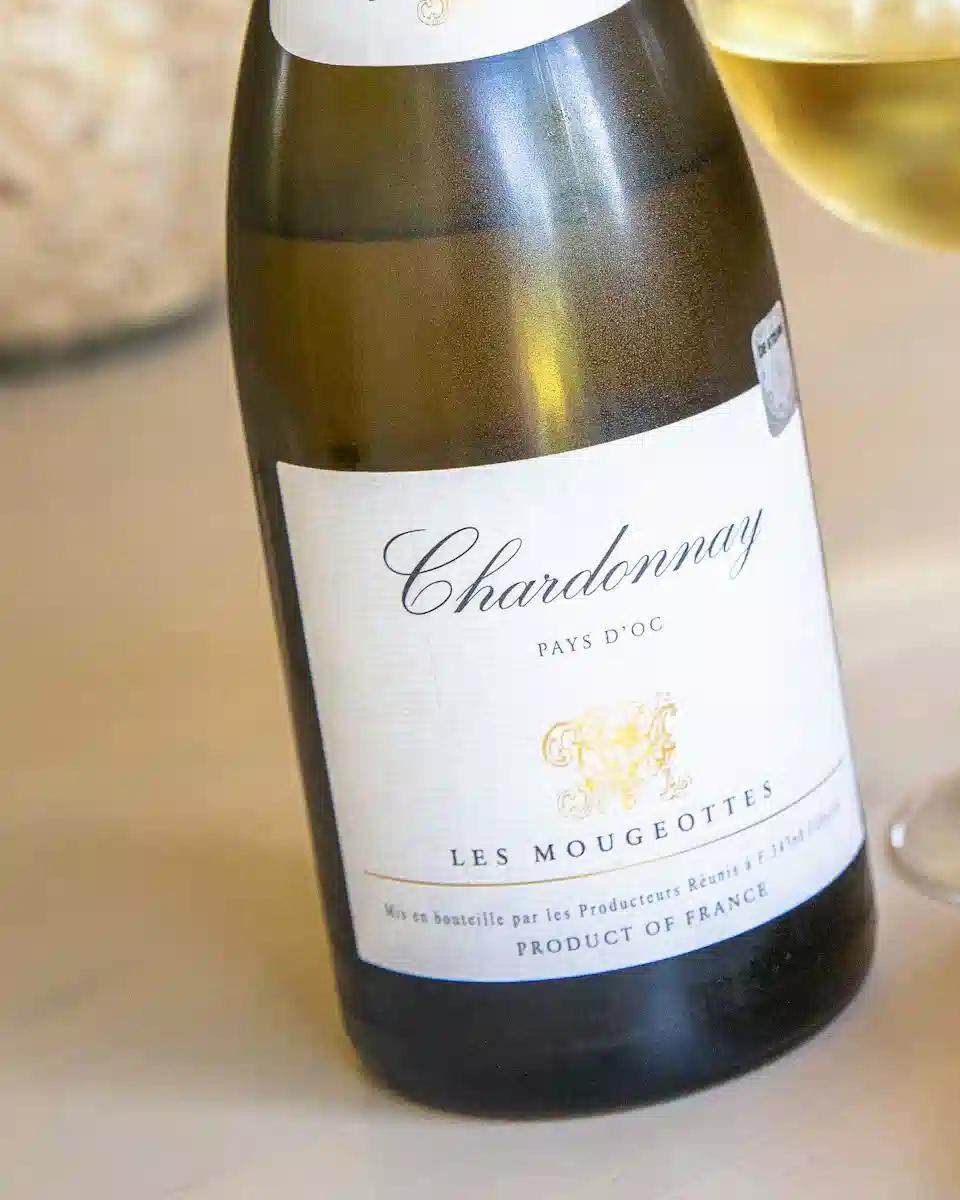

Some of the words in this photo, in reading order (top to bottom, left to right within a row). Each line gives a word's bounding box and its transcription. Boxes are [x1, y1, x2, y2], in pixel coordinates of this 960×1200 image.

[382, 508, 763, 616] Chardonnay
[537, 633, 593, 658] PAYS
[604, 616, 663, 645] D'OC
[450, 847, 509, 868] LES
[533, 779, 773, 863] MOUGEOTTES
[413, 909, 429, 923] en
[512, 912, 538, 928] par
[546, 907, 571, 923] les
[579, 881, 681, 918] Producteurs
[517, 926, 633, 957] PRODUCT
[645, 915, 676, 937] OF
[686, 881, 769, 927] FRANCE
